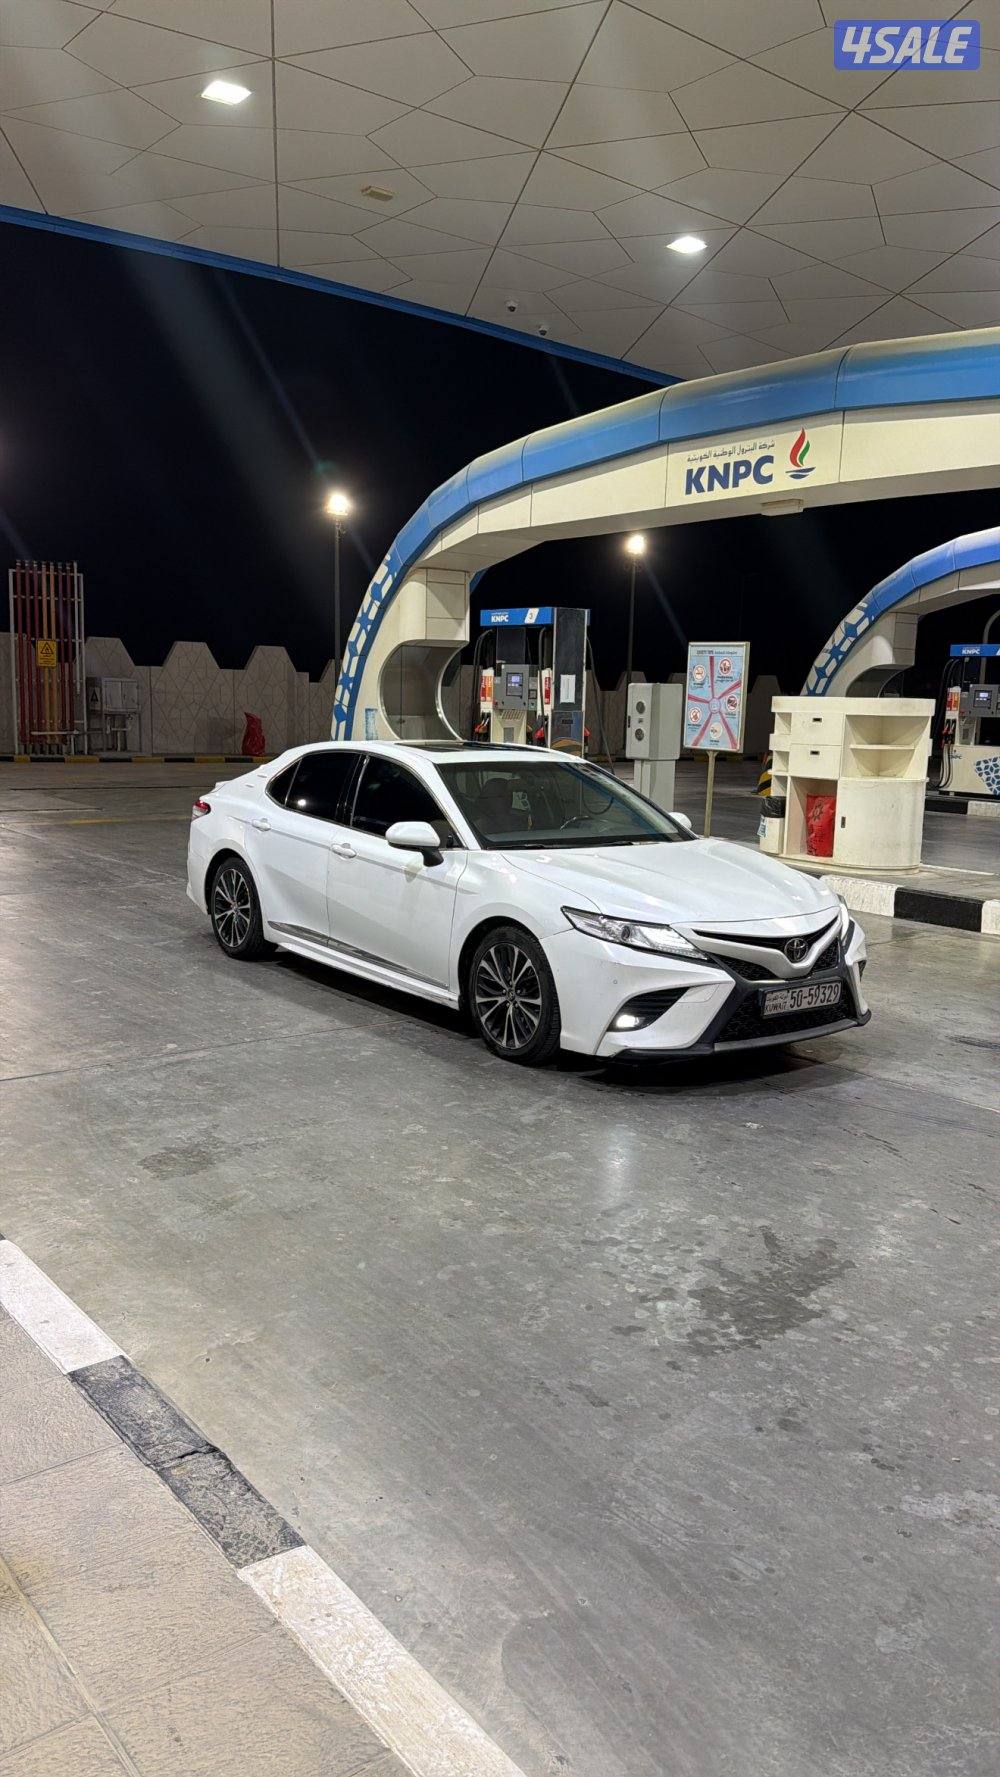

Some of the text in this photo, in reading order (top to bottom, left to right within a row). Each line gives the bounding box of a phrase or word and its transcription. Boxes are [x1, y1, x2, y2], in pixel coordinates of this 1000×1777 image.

[685, 455, 774, 495] KNPC
[491, 614, 509, 622] KNPC
[790, 984, 839, 1009] 50-59329
[765, 1001, 787, 1012] KUWAIT
